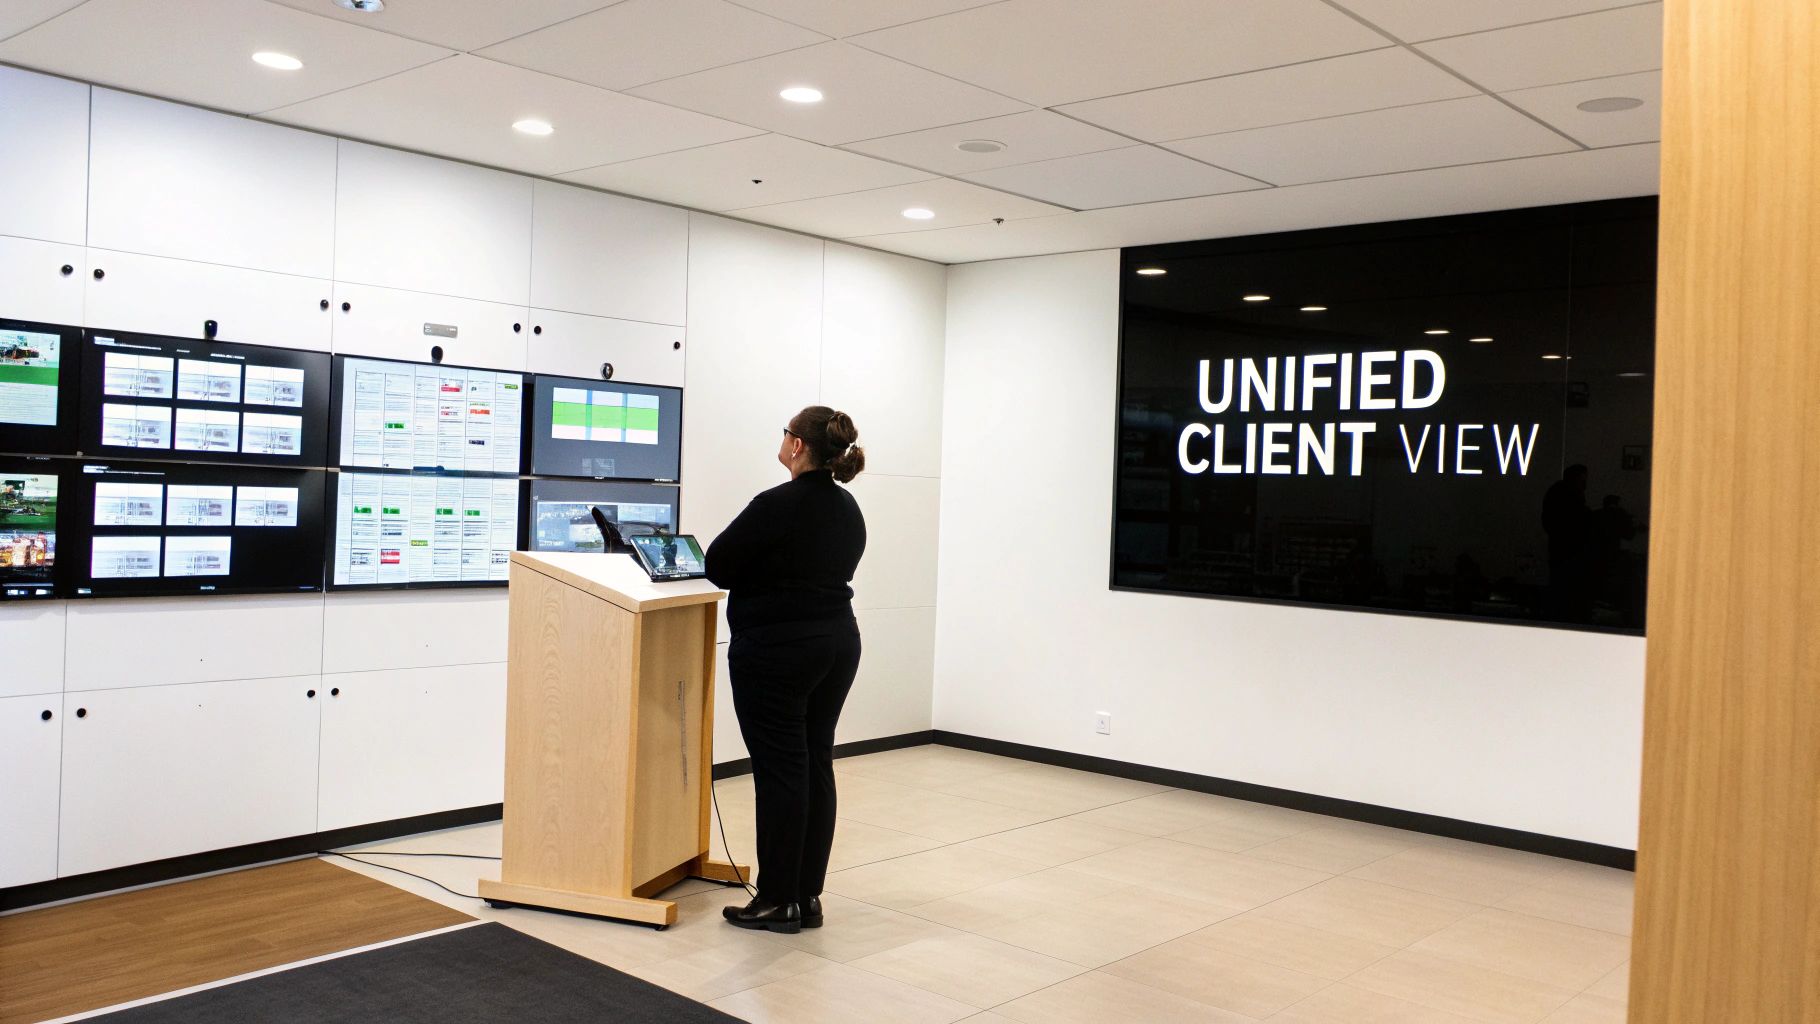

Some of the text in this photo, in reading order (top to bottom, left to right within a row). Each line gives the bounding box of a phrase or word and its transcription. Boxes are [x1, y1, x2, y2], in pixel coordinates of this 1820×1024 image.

[1198, 349, 1447, 415] UNIFIED
[1177, 422, 1540, 477] CLIENT VIEW
